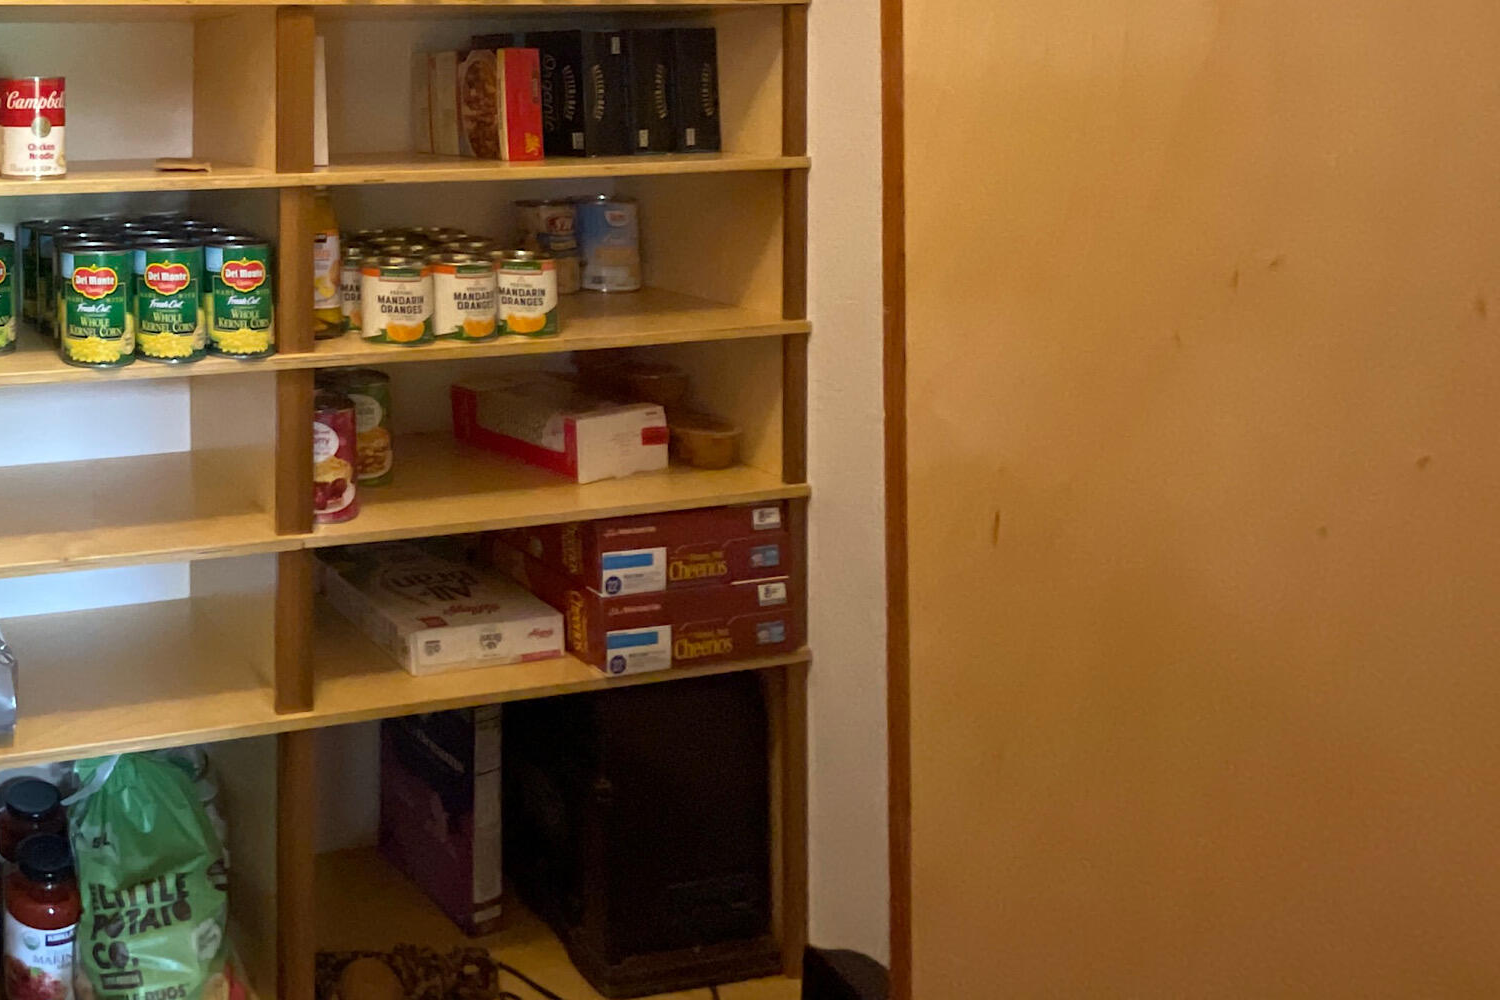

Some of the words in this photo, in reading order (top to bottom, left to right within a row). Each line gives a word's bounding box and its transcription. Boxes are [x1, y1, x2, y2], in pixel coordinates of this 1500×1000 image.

[27, 143, 55, 151] Chcken
[148, 271, 160, 280] Del
[161, 272, 187, 281] Monte
[225, 269, 237, 278] Del
[239, 269, 263, 278] Monte
[76, 275, 87, 285] Del
[89, 276, 114, 285] Monte
[454, 292, 496, 301] MANDAR
[499, 286, 546, 297] MANDARIN
[378, 295, 424, 305] MANDARIN
[501, 296, 544, 306] ORANGES
[381, 304, 422, 314] ORANGES
[457, 301, 495, 310] ORANGE
[153, 311, 183, 322] WHOLE
[231, 308, 260, 319] WHOLE
[81, 315, 110, 327] WHOLE
[99, 326, 122, 337] CORN
[172, 321, 195, 332] CORN
[98, 872, 190, 910] LITTLE
[90, 899, 192, 940] POTATO
[92, 940, 139, 969] CO.
